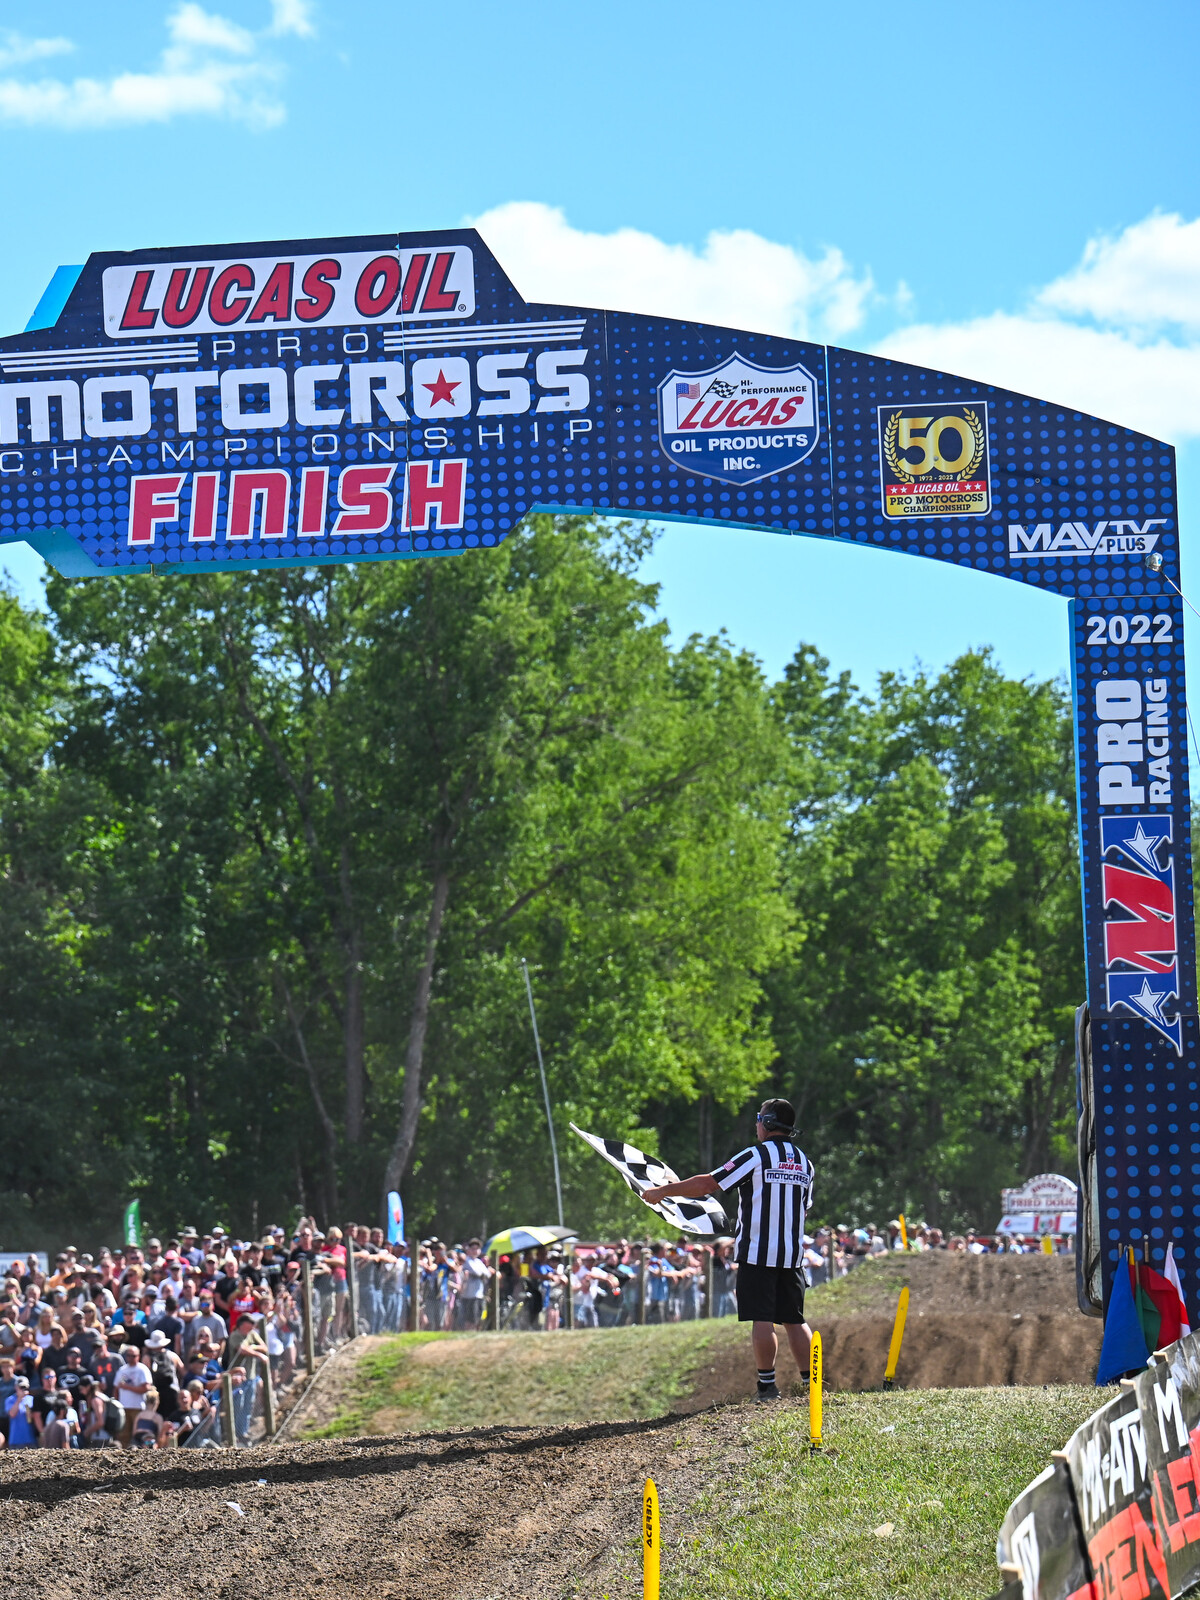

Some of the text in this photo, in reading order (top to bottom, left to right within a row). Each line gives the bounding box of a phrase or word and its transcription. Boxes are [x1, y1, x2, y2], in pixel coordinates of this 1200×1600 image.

[119, 251, 461, 330] LUCAS OIL
[213, 333, 369, 360] PRO
[741, 385, 807, 395] PERFORMANCE
[678, 396, 805, 430] LUCAS
[671, 433, 809, 453] OIL PRODUCTS
[897, 416, 975, 475] 50
[127, 458, 468, 546] FINISH
[889, 493, 983, 505] PRO MOTOCROSS
[913, 483, 959, 493] LUCAS OIL
[903, 504, 971, 513] CHAMPIONSHIP
[1106, 537, 1145, 552] PLUS
[1087, 614, 1173, 645] 2022
[1095, 679, 1145, 806] PRO
[1148, 678, 1172, 804] RACING
[1100, 814, 1183, 1057] AMA
